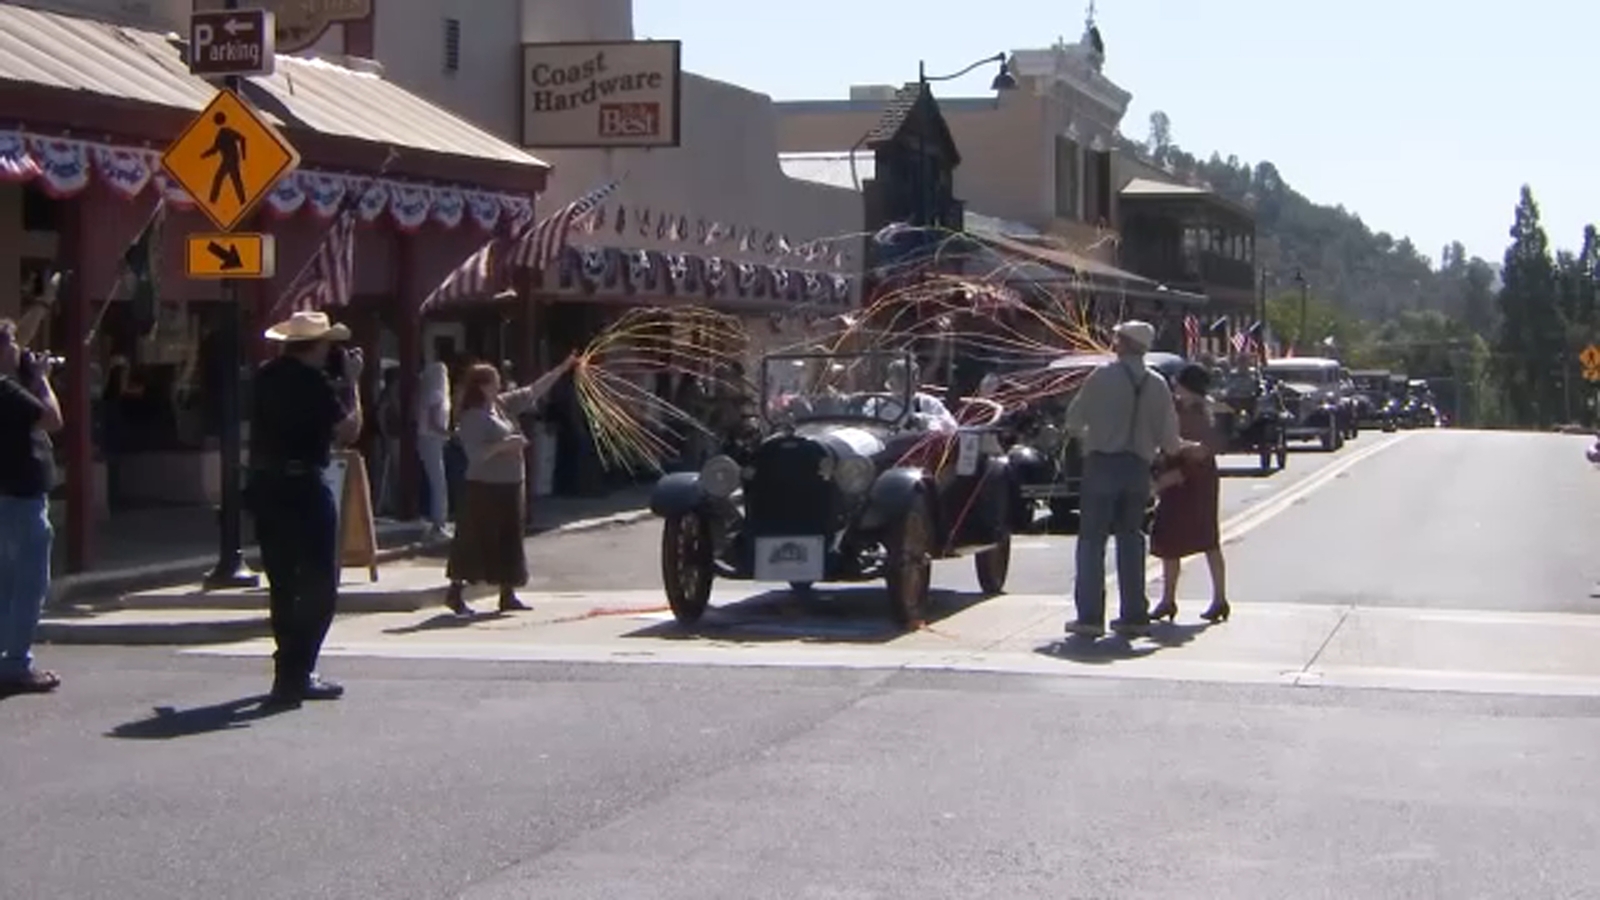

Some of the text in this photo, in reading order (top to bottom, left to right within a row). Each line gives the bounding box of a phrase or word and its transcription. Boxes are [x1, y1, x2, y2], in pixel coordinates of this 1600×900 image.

[194, 24, 259, 65] Parking
[532, 52, 608, 87] Coast
[533, 71, 662, 112] Hardware
[602, 109, 654, 134] Best
